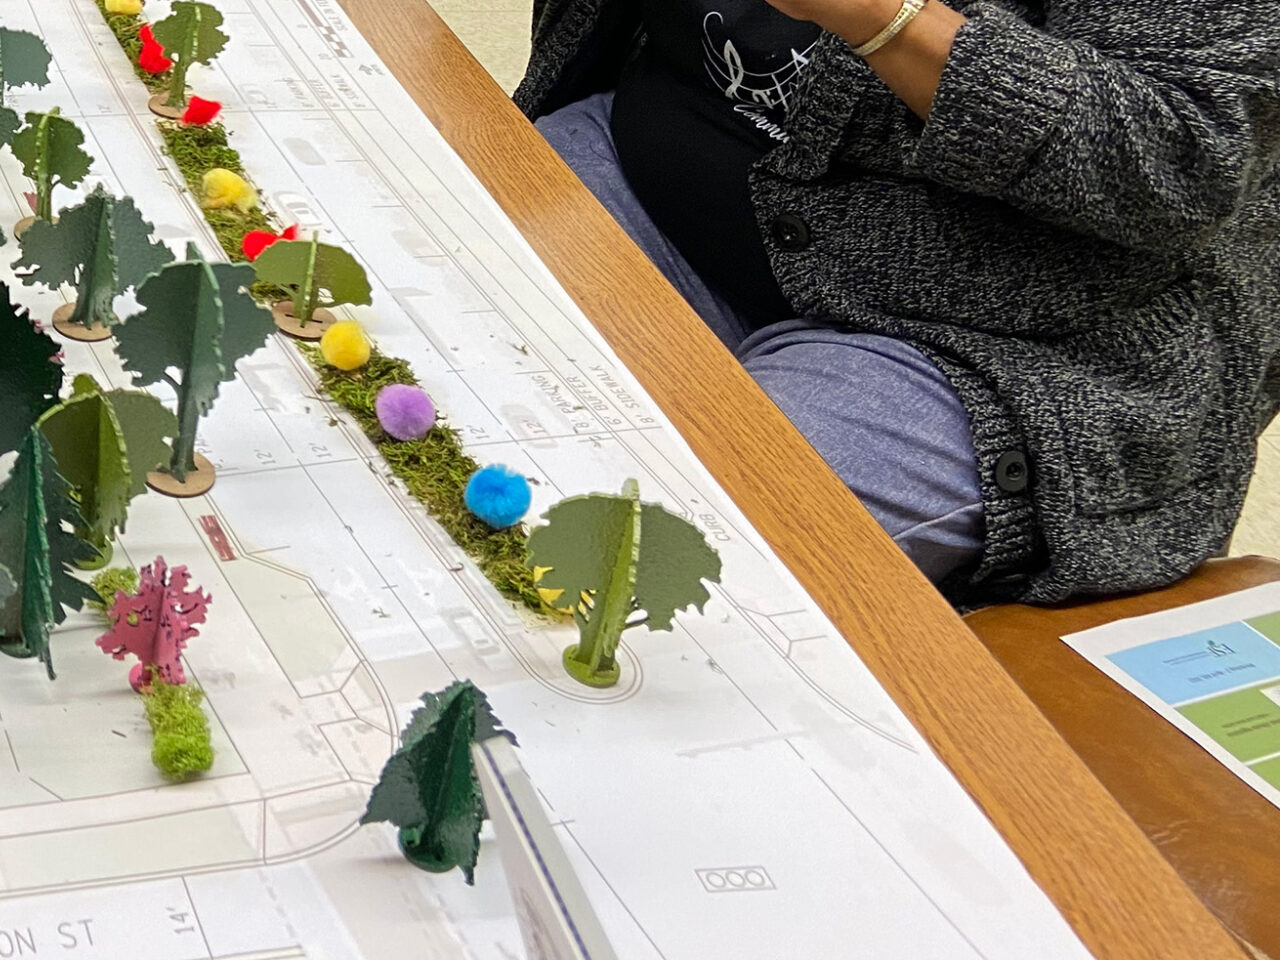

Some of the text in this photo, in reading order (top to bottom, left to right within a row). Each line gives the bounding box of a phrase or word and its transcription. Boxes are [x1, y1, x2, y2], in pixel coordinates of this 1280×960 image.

[531, 375, 577, 414] PARKING
[567, 376, 608, 412] BUFFER
[589, 365, 655, 424] 8' SIDEWALK
[254, 449, 276, 465] 12'
[308, 442, 332, 458] 12'
[699, 513, 731, 542] CURB
[57, 918, 96, 948] ST
[167, 906, 196, 936] 14'
